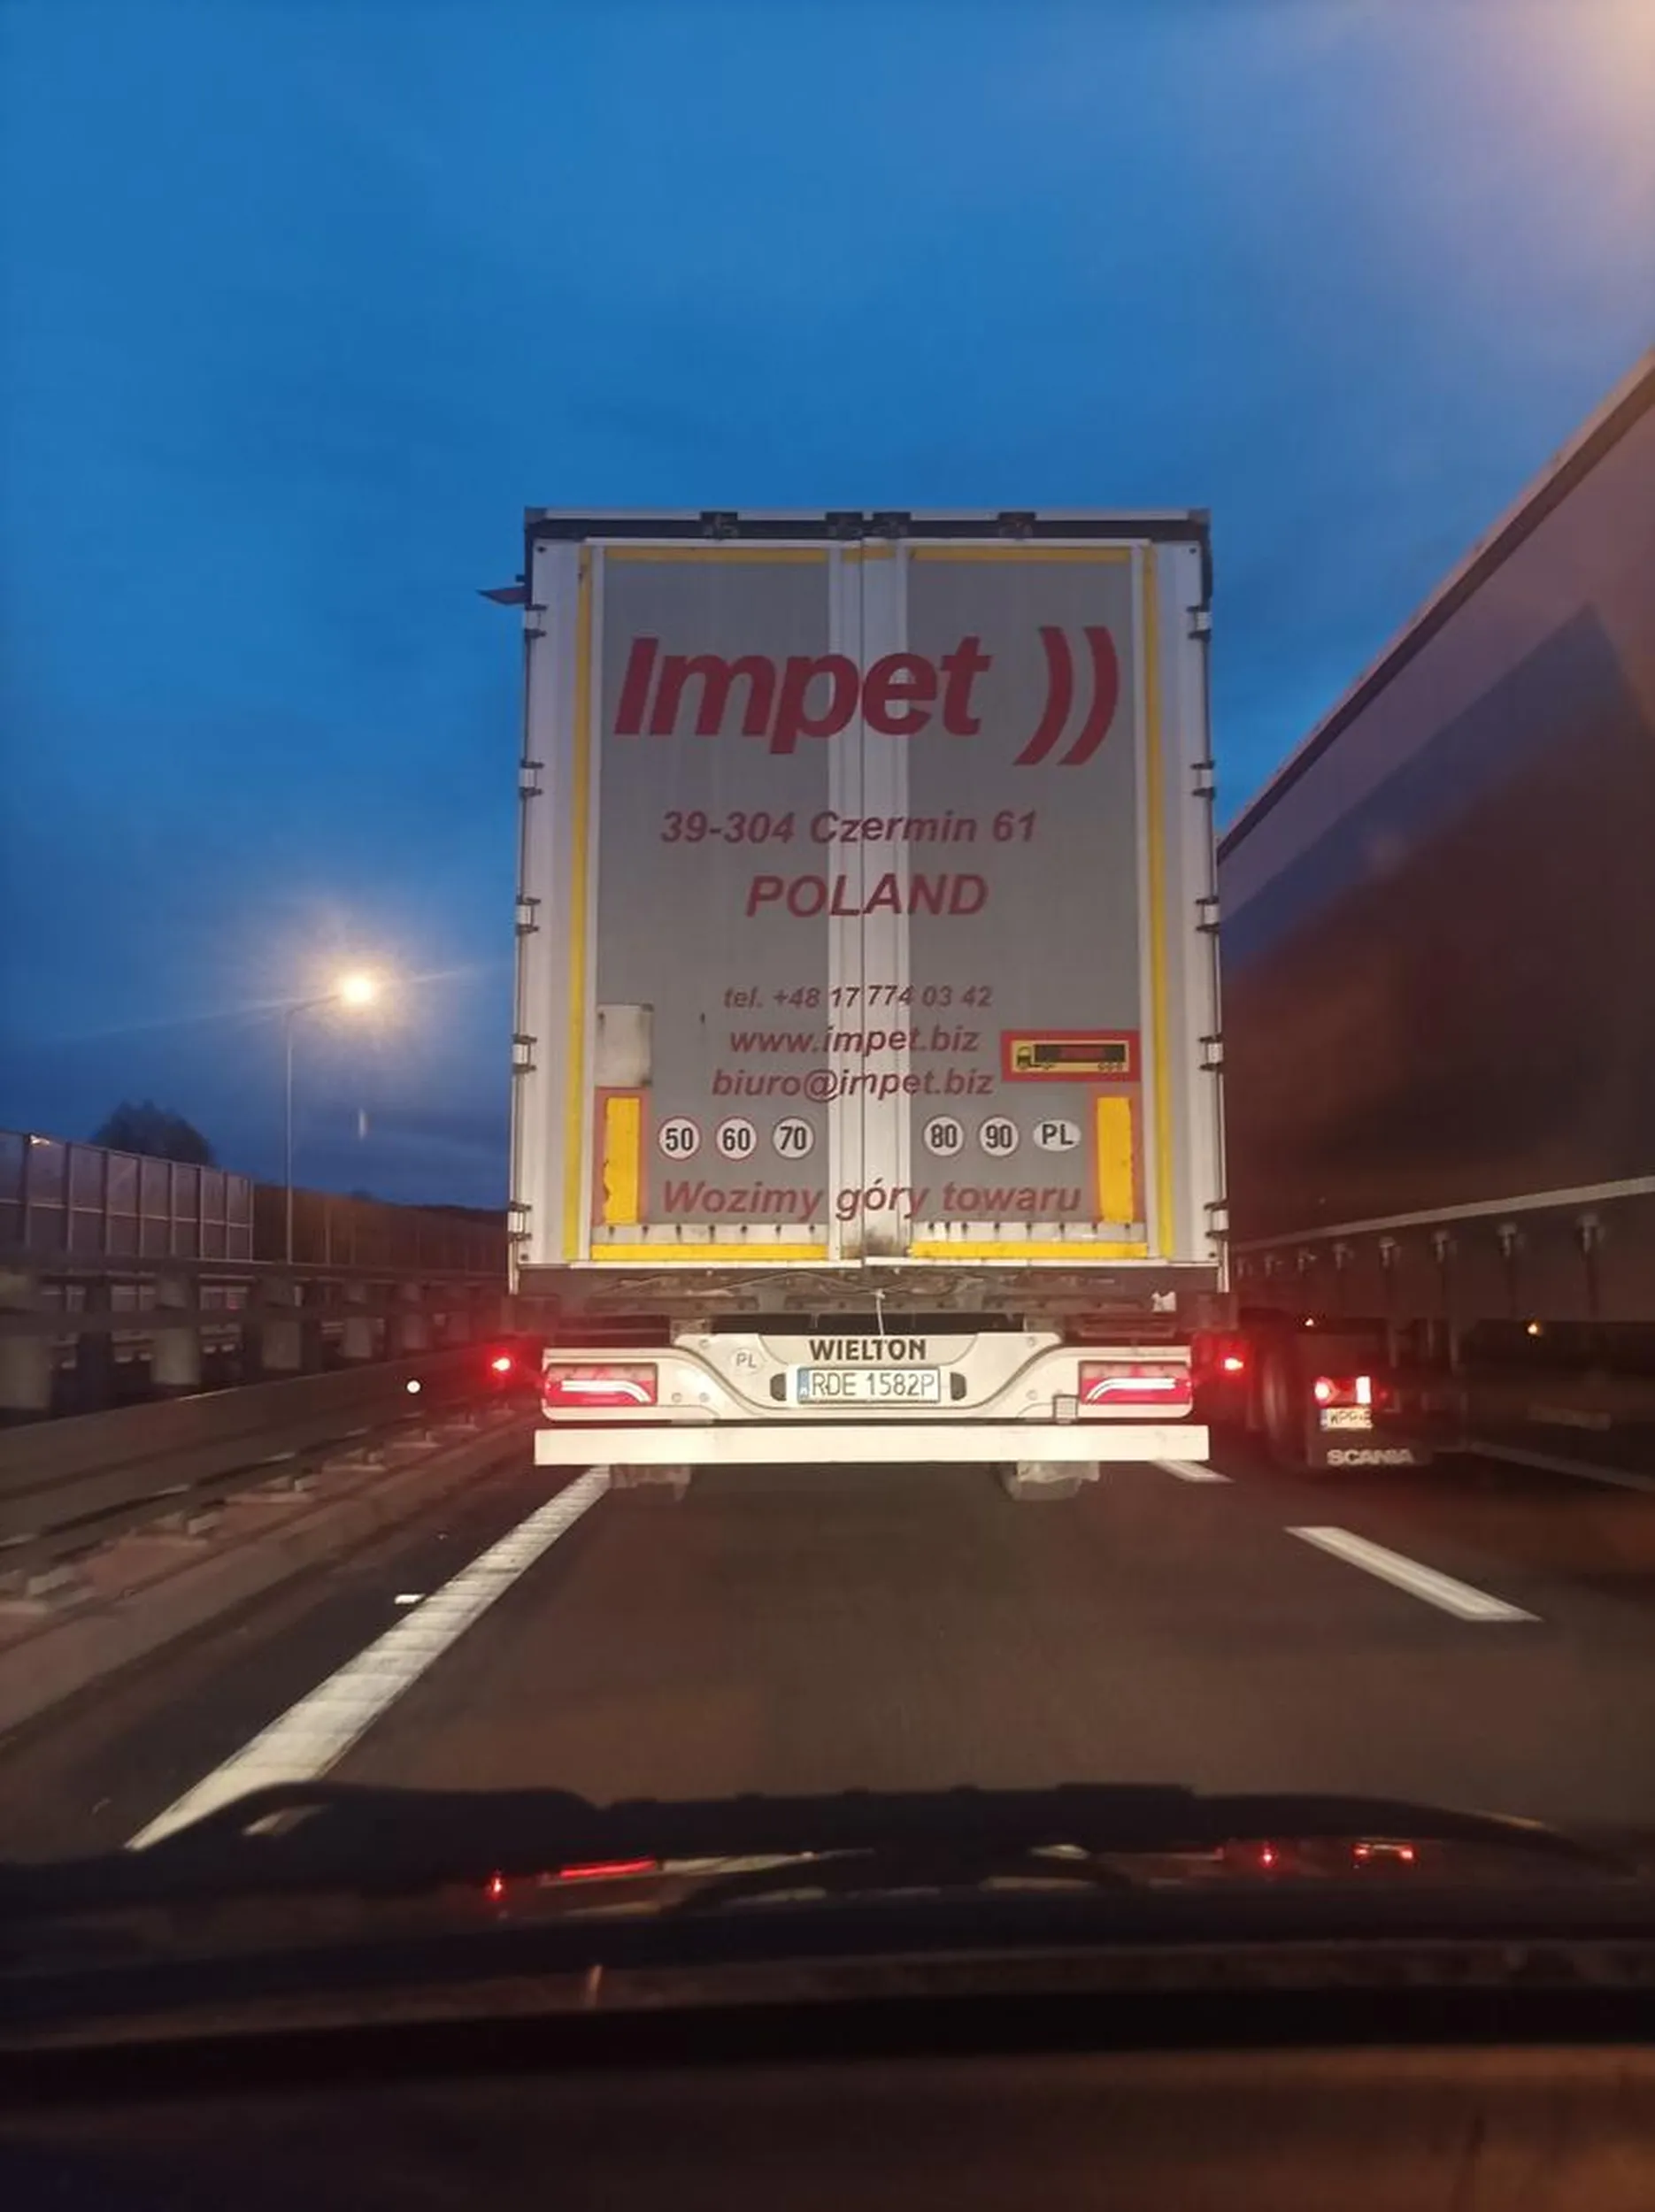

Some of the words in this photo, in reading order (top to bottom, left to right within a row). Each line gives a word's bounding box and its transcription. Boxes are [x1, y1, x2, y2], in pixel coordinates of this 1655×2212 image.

[613, 636, 991, 754] Impet
[660, 810, 795, 845] 39-304
[809, 810, 977, 844] Czermin
[992, 810, 1037, 842] 61
[745, 873, 989, 918] POLAND
[724, 987, 763, 1009] tel.
[773, 987, 820, 1009] +48
[831, 987, 859, 1009] 17
[867, 985, 914, 1008] 774
[922, 986, 953, 1008] 03
[961, 986, 993, 1008] 42
[730, 1026, 979, 1057] www.impet.biz
[712, 1068, 994, 1102] biuro@impet.biz
[665, 1128, 694, 1151] 50
[722, 1128, 751, 1151] 60
[779, 1126, 807, 1150] 70
[930, 1124, 958, 1148] 80
[985, 1124, 1012, 1148] 90
[1042, 1125, 1073, 1145] PL
[664, 1180, 823, 1217] Wozimy
[835, 1178, 929, 1221] góry
[942, 1181, 1082, 1212] towaru
[736, 1353, 757, 1368] PL
[809, 1339, 927, 1360] WIELTON
[812, 1372, 857, 1395] RDE
[866, 1371, 935, 1395] 1582P
[1328, 1448, 1415, 1465] SCANIA
